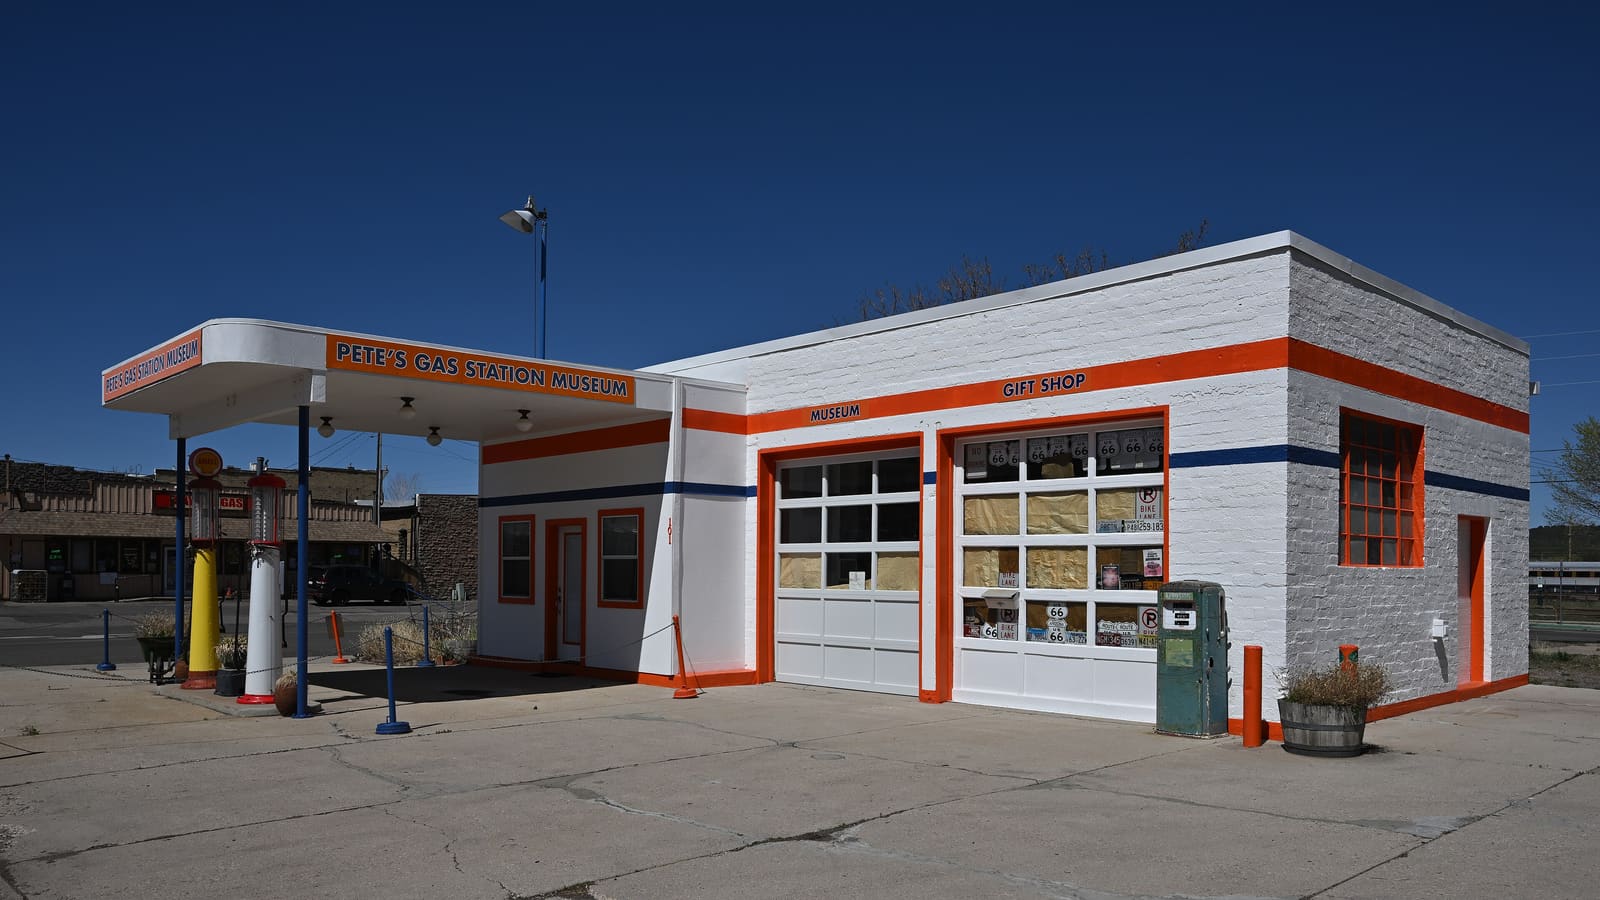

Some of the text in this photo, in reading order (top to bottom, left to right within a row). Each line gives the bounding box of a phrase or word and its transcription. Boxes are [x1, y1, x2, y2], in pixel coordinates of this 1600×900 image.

[106, 338, 198, 393] PETE'S GAS STATION MUSEUM
[337, 342, 628, 397] PETE'S GAS STATION MUSEUM
[1003, 373, 1086, 397] GIFT SHOP
[811, 404, 860, 422] MUSEUM
[1075, 446, 1088, 456] 66
[1101, 445, 1115, 455] 66
[1126, 442, 1141, 453] 66
[992, 454, 1005, 464] 66
[1011, 455, 1018, 464] 6
[1032, 450, 1045, 460] 66
[220, 497, 243, 508] GAS
[1140, 505, 1156, 513] BIKE
[1050, 607, 1064, 617] 66
[985, 627, 997, 638] 66
[1001, 631, 1015, 639] LANE
[1050, 632, 1063, 642] 66
